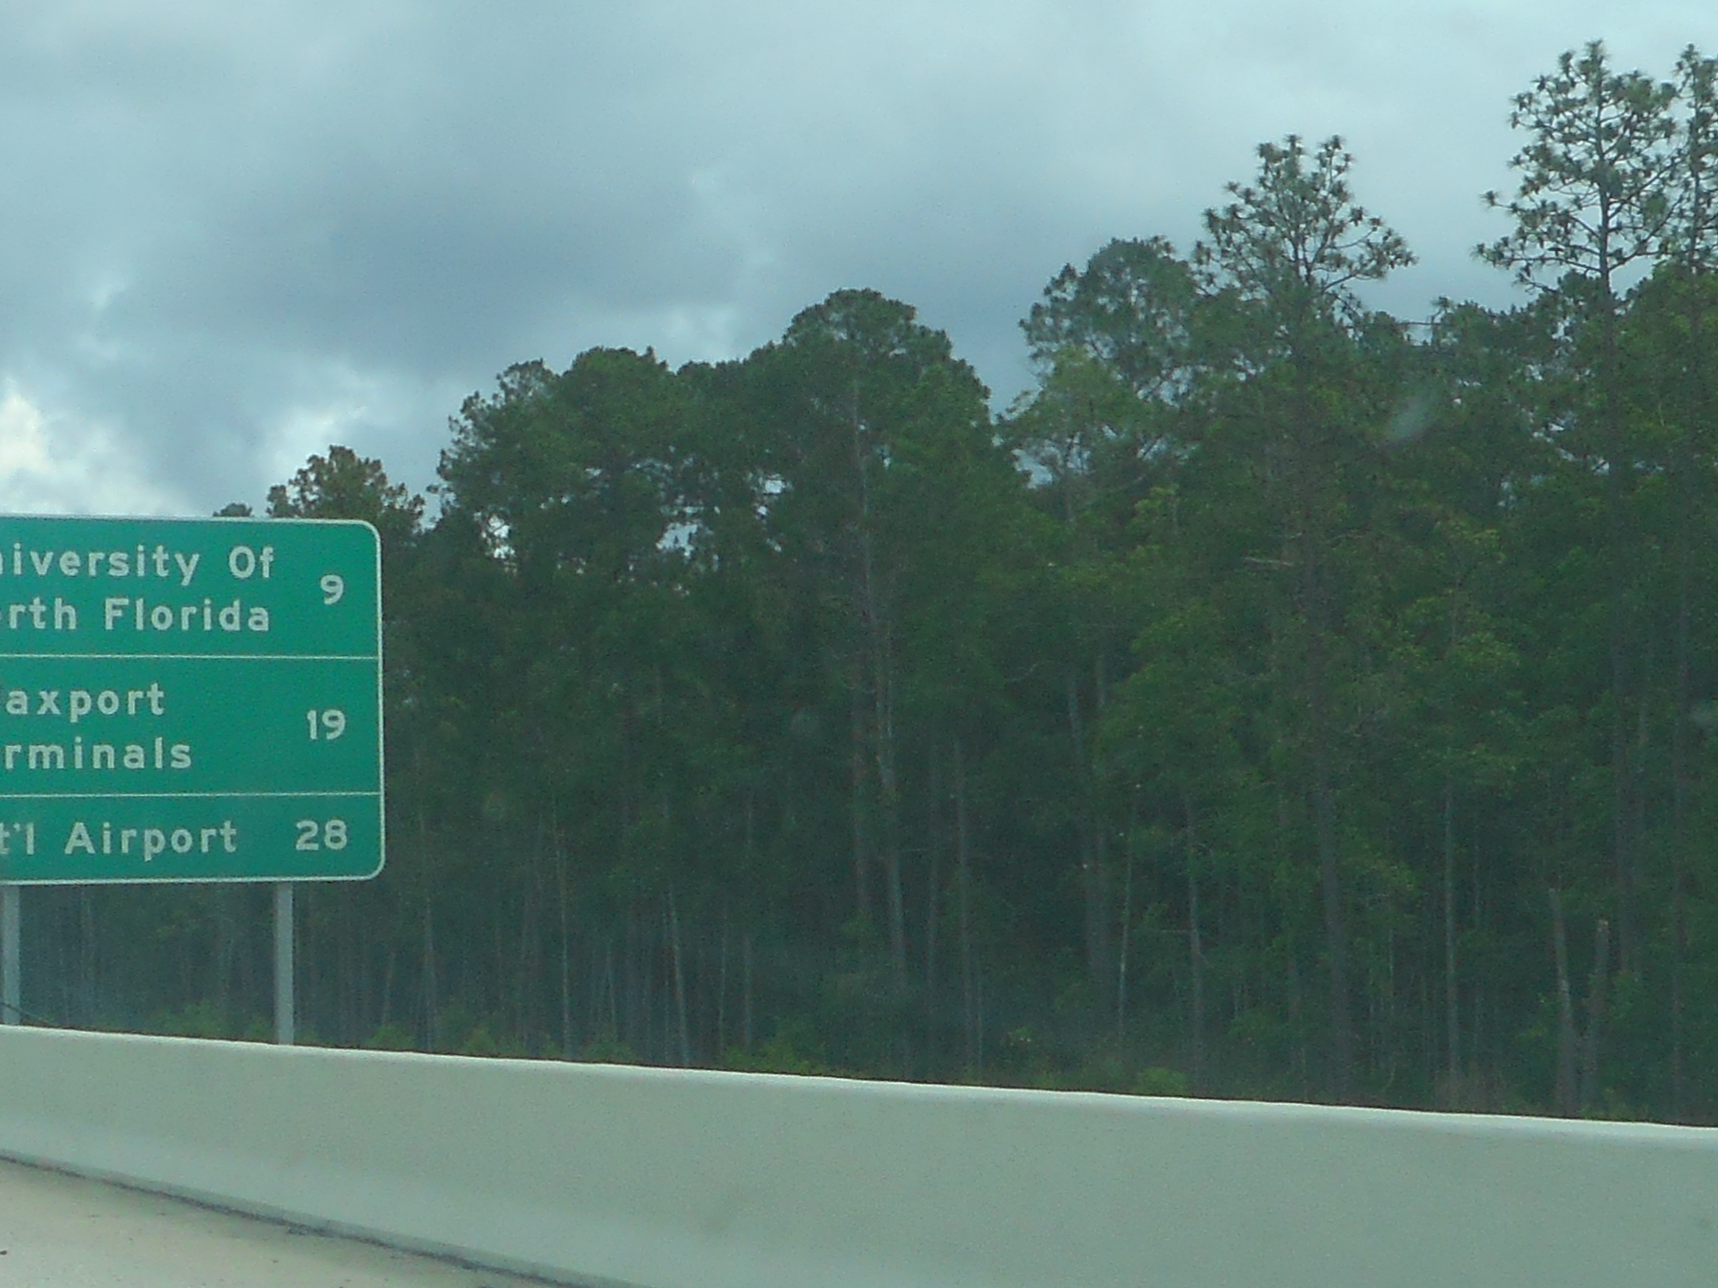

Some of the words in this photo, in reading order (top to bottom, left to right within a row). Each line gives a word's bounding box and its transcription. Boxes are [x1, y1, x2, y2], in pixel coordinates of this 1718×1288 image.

[229, 545, 274, 579] Of
[320, 574, 344, 605] 9
[105, 597, 269, 632] Florida
[306, 708, 346, 740] 19
[64, 821, 237, 861] Airport
[295, 819, 348, 850] 28
